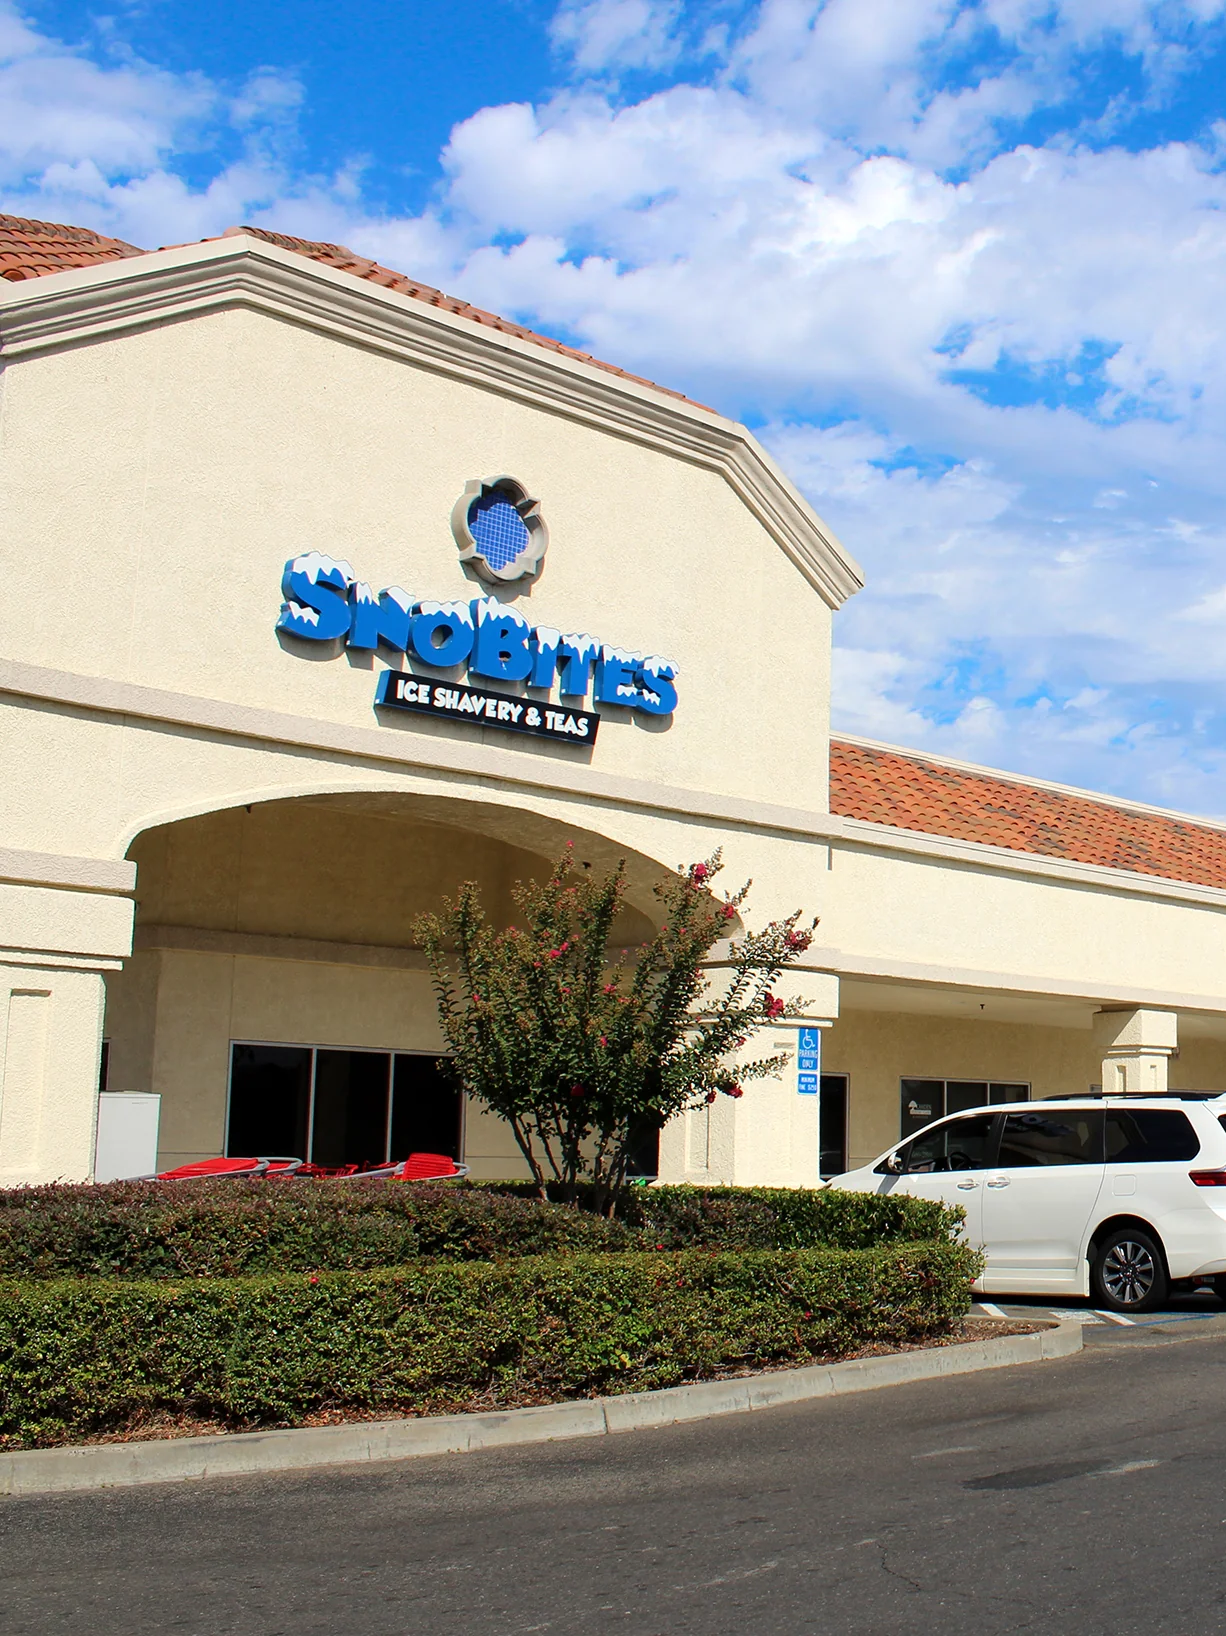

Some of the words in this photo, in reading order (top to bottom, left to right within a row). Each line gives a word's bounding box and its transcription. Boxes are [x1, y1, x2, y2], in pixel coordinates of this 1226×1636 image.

[396, 679, 431, 706] ICE
[433, 682, 523, 726] SHAVERY
[525, 706, 542, 728] &
[545, 710, 589, 737] TEAS
[799, 1049, 818, 1059] PARKING
[801, 1059, 814, 1069] ONLY
